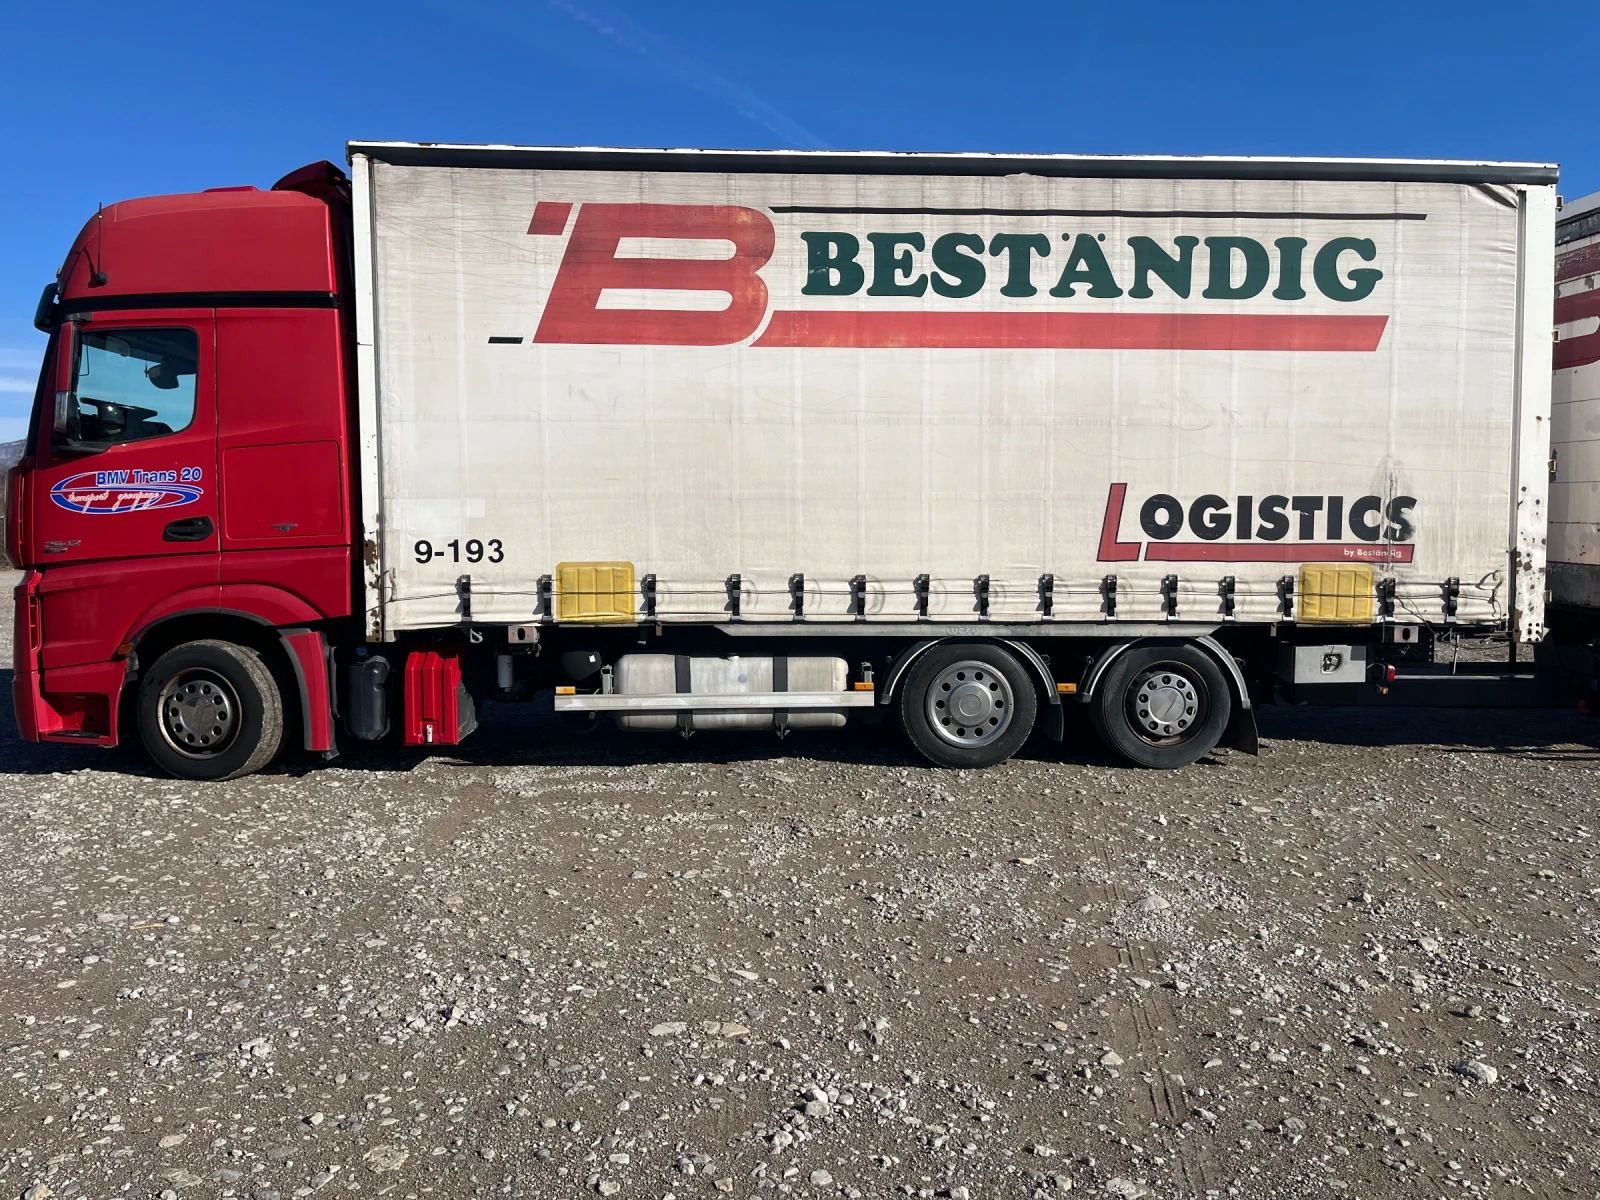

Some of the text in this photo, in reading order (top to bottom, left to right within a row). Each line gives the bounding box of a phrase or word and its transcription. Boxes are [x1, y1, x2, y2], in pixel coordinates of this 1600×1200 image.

[800, 231, 1384, 302] BESTÄNDIG
[96, 467, 203, 486] BMV Trans 20
[68, 490, 110, 514] transport
[1096, 482, 1418, 562] LOGISTICS
[414, 538, 505, 564] 9-193
[1343, 548, 1355, 558] by
